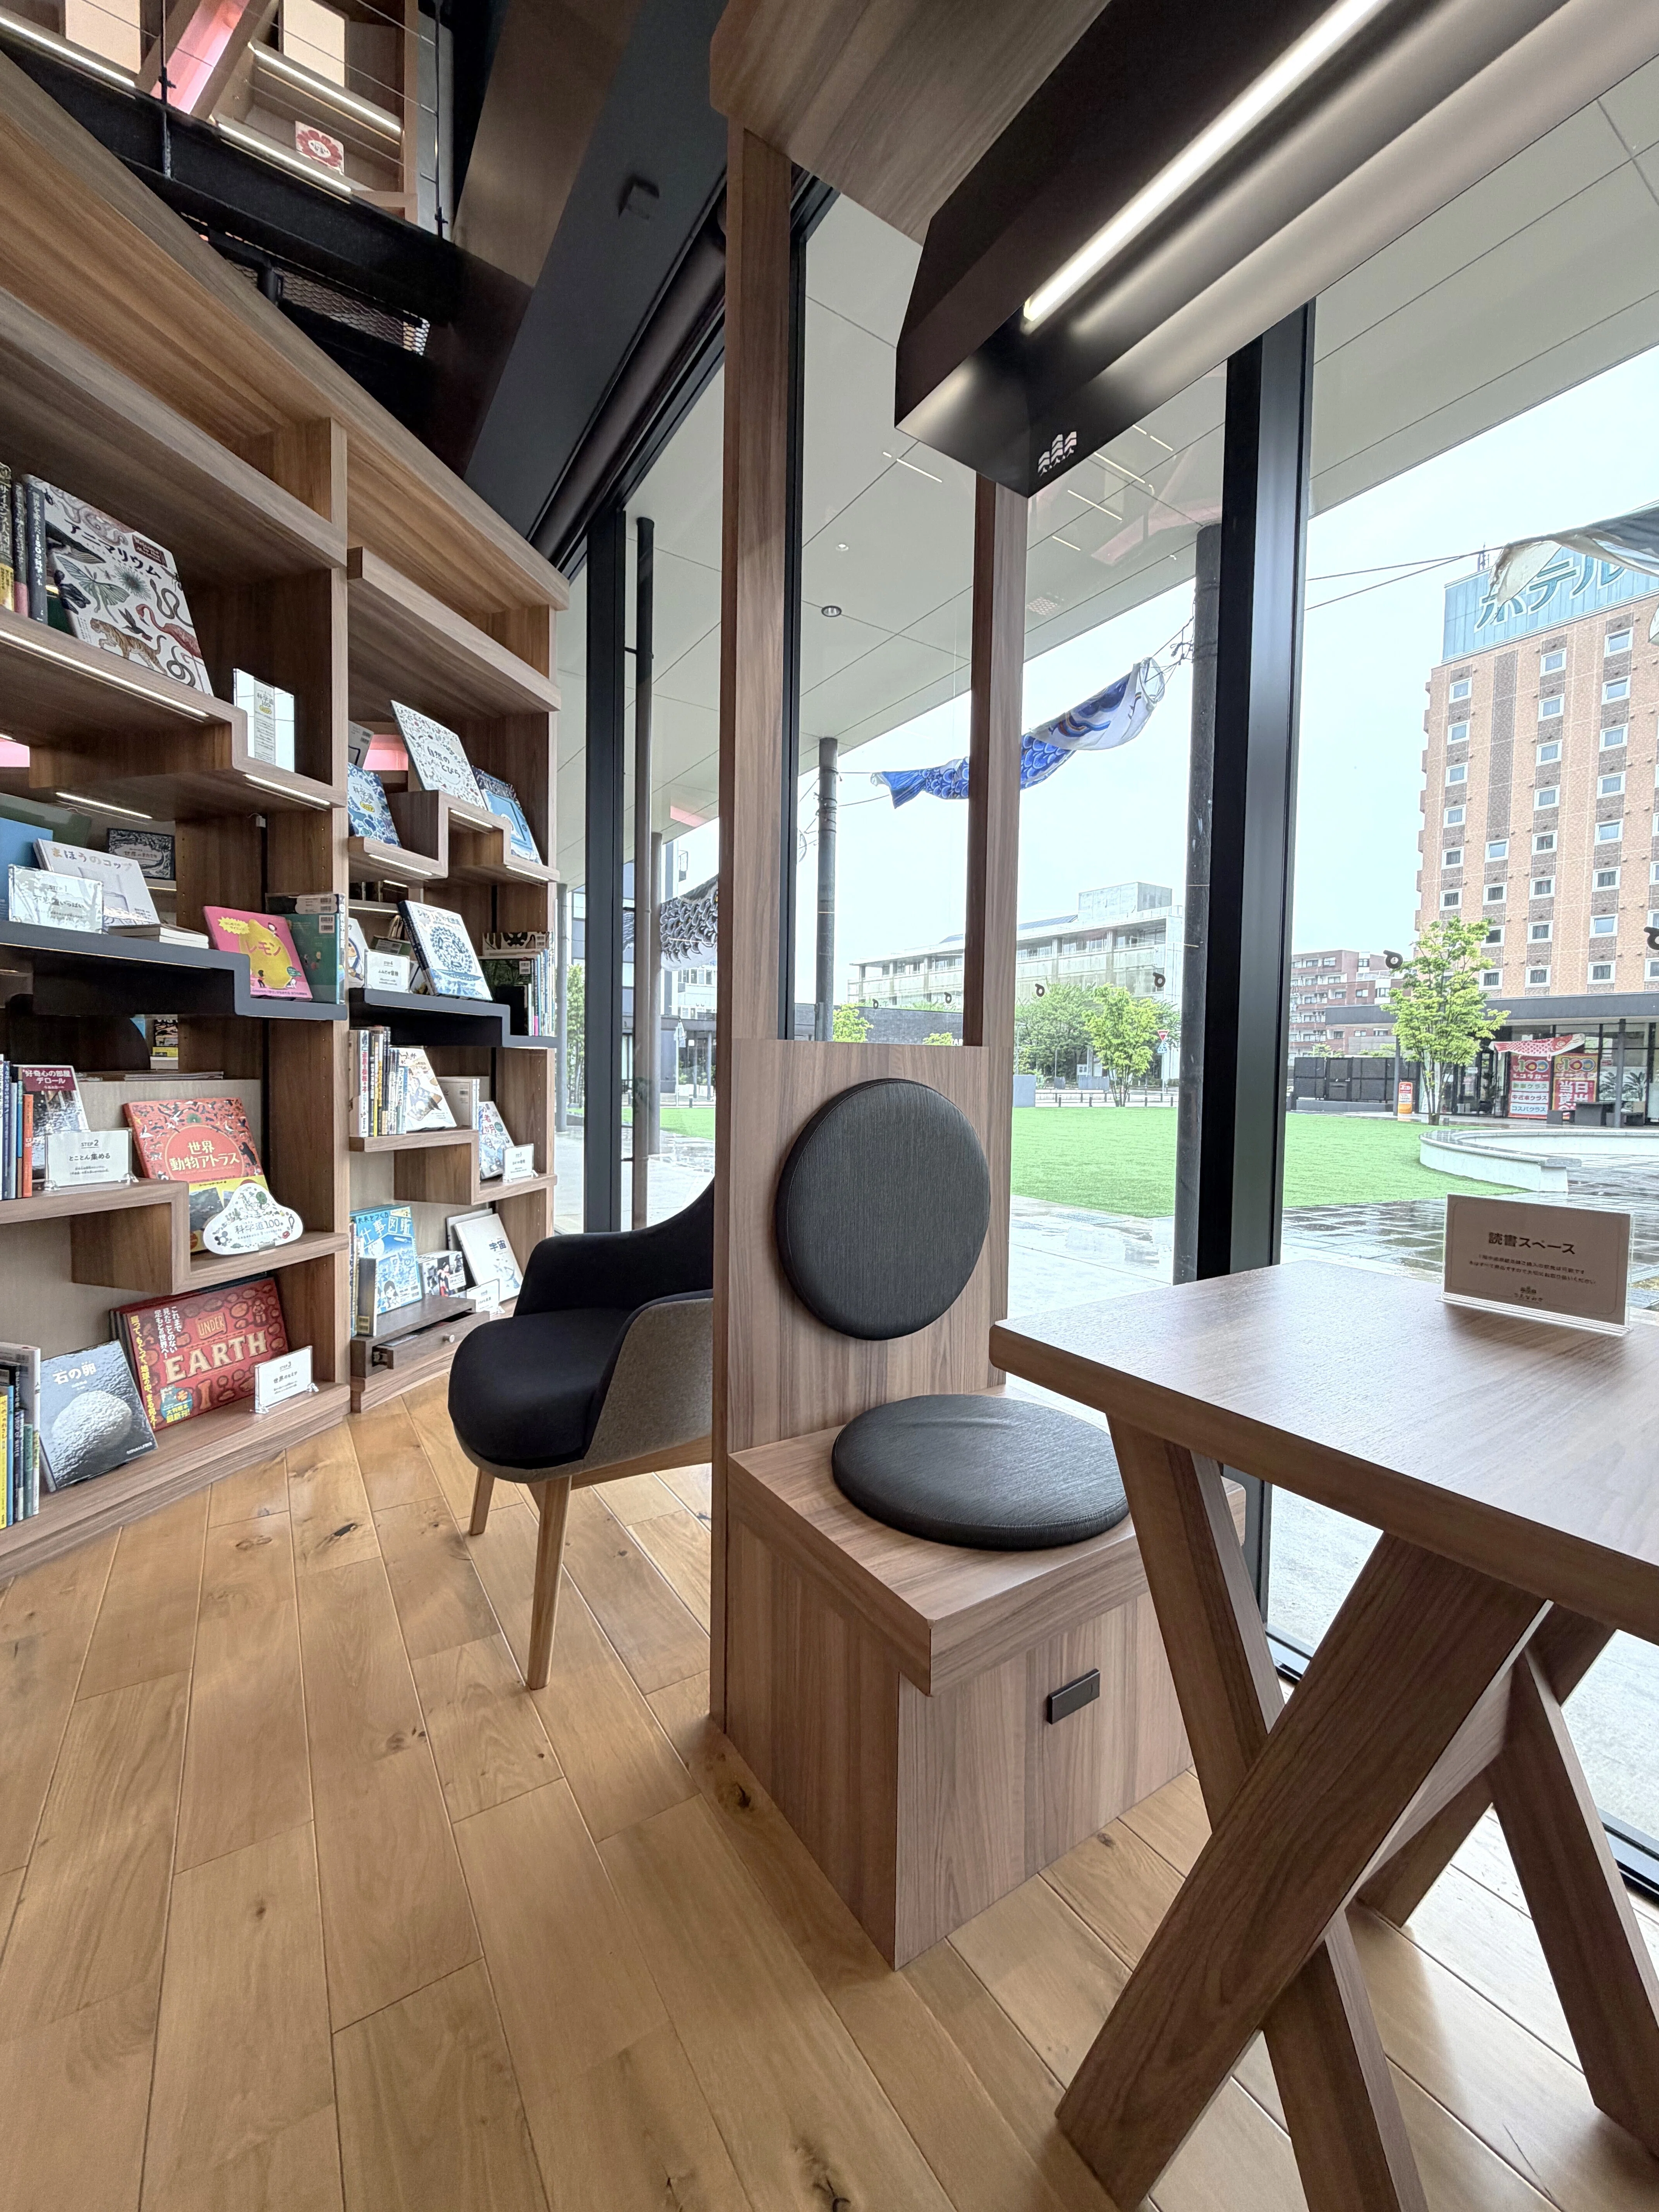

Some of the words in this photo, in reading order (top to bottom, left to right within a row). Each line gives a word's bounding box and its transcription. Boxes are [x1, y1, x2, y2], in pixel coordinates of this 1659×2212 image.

[64, 519, 162, 580] アニマリウム
[439, 762, 461, 778] とびら
[52, 847, 132, 871] まほうのコップ
[245, 941, 281, 957] レモン
[1518, 1059, 1549, 1073] 100
[1561, 1058, 1595, 1071] 100
[1559, 1081, 1588, 1093] 当日
[69, 1152, 111, 1161] とことん集める
[187, 1140, 215, 1155] 世界
[169, 1152, 240, 1171] 動物アトラス
[489, 1240, 507, 1252] 宇宙
[1489, 1231, 1575, 1255] 読書スペース
[171, 1306, 182, 1332] これまで
[198, 1316, 225, 1336] UNDER
[163, 1307, 178, 1354] 見たことのない
[164, 1330, 268, 1384] EARTH
[52, 1362, 97, 1385] 石の卵
